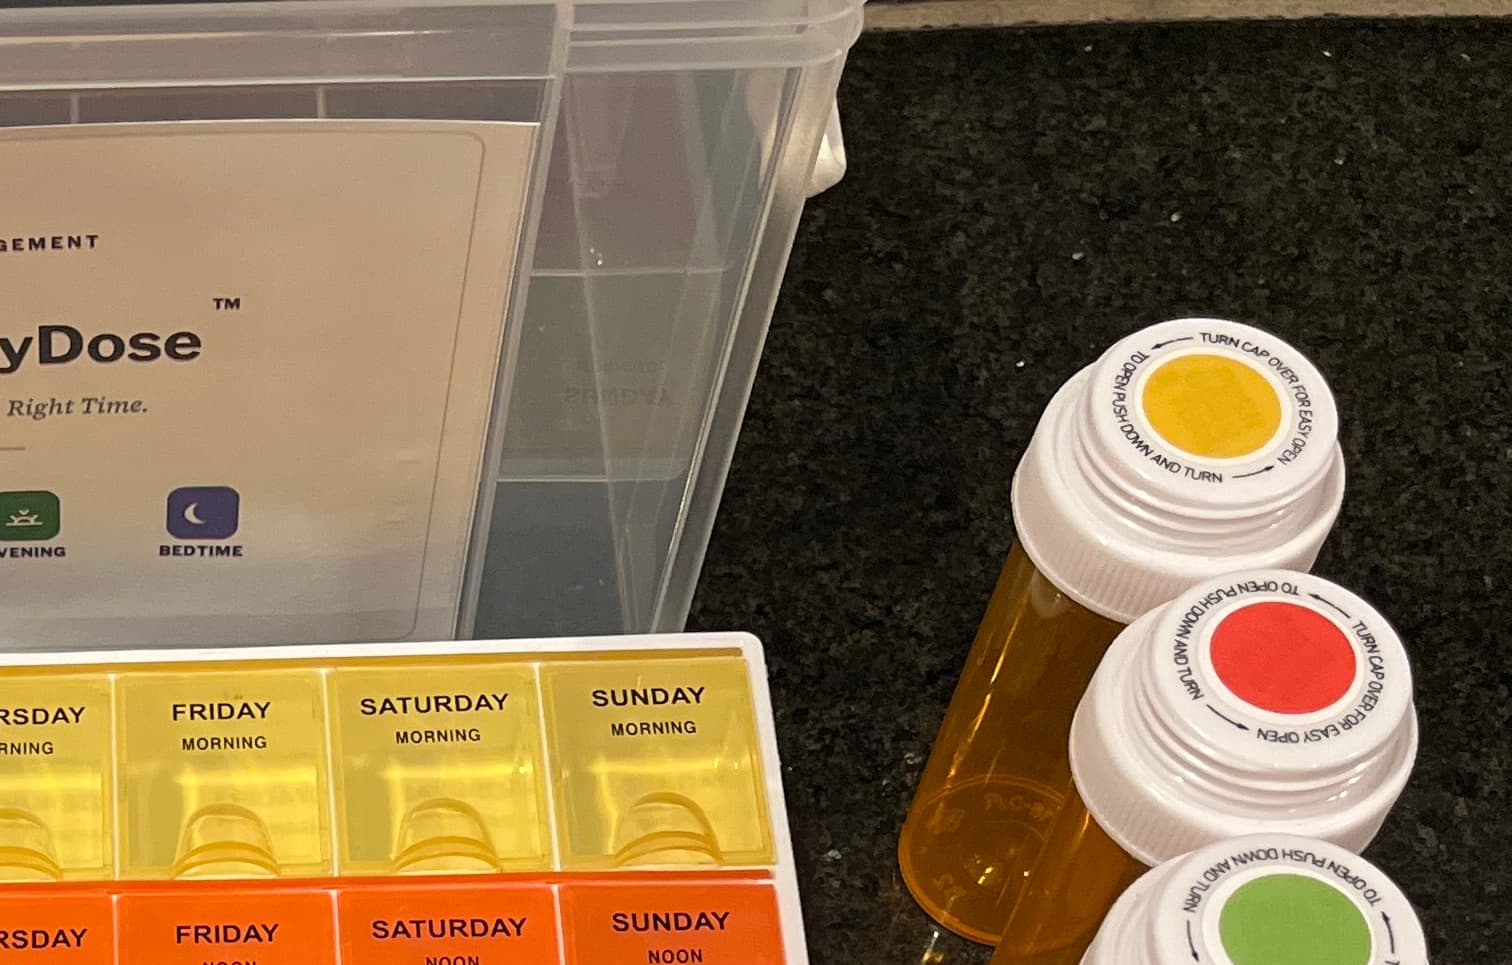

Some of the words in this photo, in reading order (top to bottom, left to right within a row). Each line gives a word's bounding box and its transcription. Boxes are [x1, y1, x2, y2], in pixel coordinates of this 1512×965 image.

[1130, 351, 1151, 365] TO
[1113, 362, 1138, 392] OPEN
[1200, 332, 1241, 349] TURN
[1241, 341, 1271, 358] CAP
[1268, 357, 1300, 385] OVER
[1292, 385, 1312, 408] FOR
[7, 397, 75, 421] Right
[81, 396, 148, 415] Time.
[1112, 392, 1130, 424] PUSH
[1120, 421, 1155, 457] DOWN
[1150, 454, 1182, 474] AND
[1184, 466, 1223, 484] TURN
[159, 545, 243, 557] BEDTIME
[1198, 586, 1238, 610] PUSH
[1237, 581, 1279, 595] OPEN
[1281, 582, 1300, 597] TO
[1352, 620, 1381, 654] TURN
[1368, 655, 1386, 681] CAP
[1178, 668, 1205, 701] TURN
[360, 693, 509, 716] SATURDAY
[592, 686, 705, 707] SUNDAY
[1358, 679, 1384, 712] OVER
[172, 701, 271, 721] FRIDAY
[1337, 705, 1368, 731] FOR
[395, 728, 481, 744] MORNING
[611, 720, 697, 736] MORNING
[1257, 728, 1300, 744] OPEN
[1304, 722, 1345, 744] EASY
[182, 735, 267, 751] MORNING
[1231, 847, 1279, 864] DOWN
[1282, 849, 1327, 869] PUSH
[1326, 861, 1368, 892] OPEN
[1183, 881, 1212, 913] TURN
[1363, 888, 1382, 907] TO
[372, 917, 527, 939] SATURDAY
[612, 911, 730, 932] SUNDAY
[176, 923, 279, 944] FRIDAY
[648, 949, 703, 964] NOON
